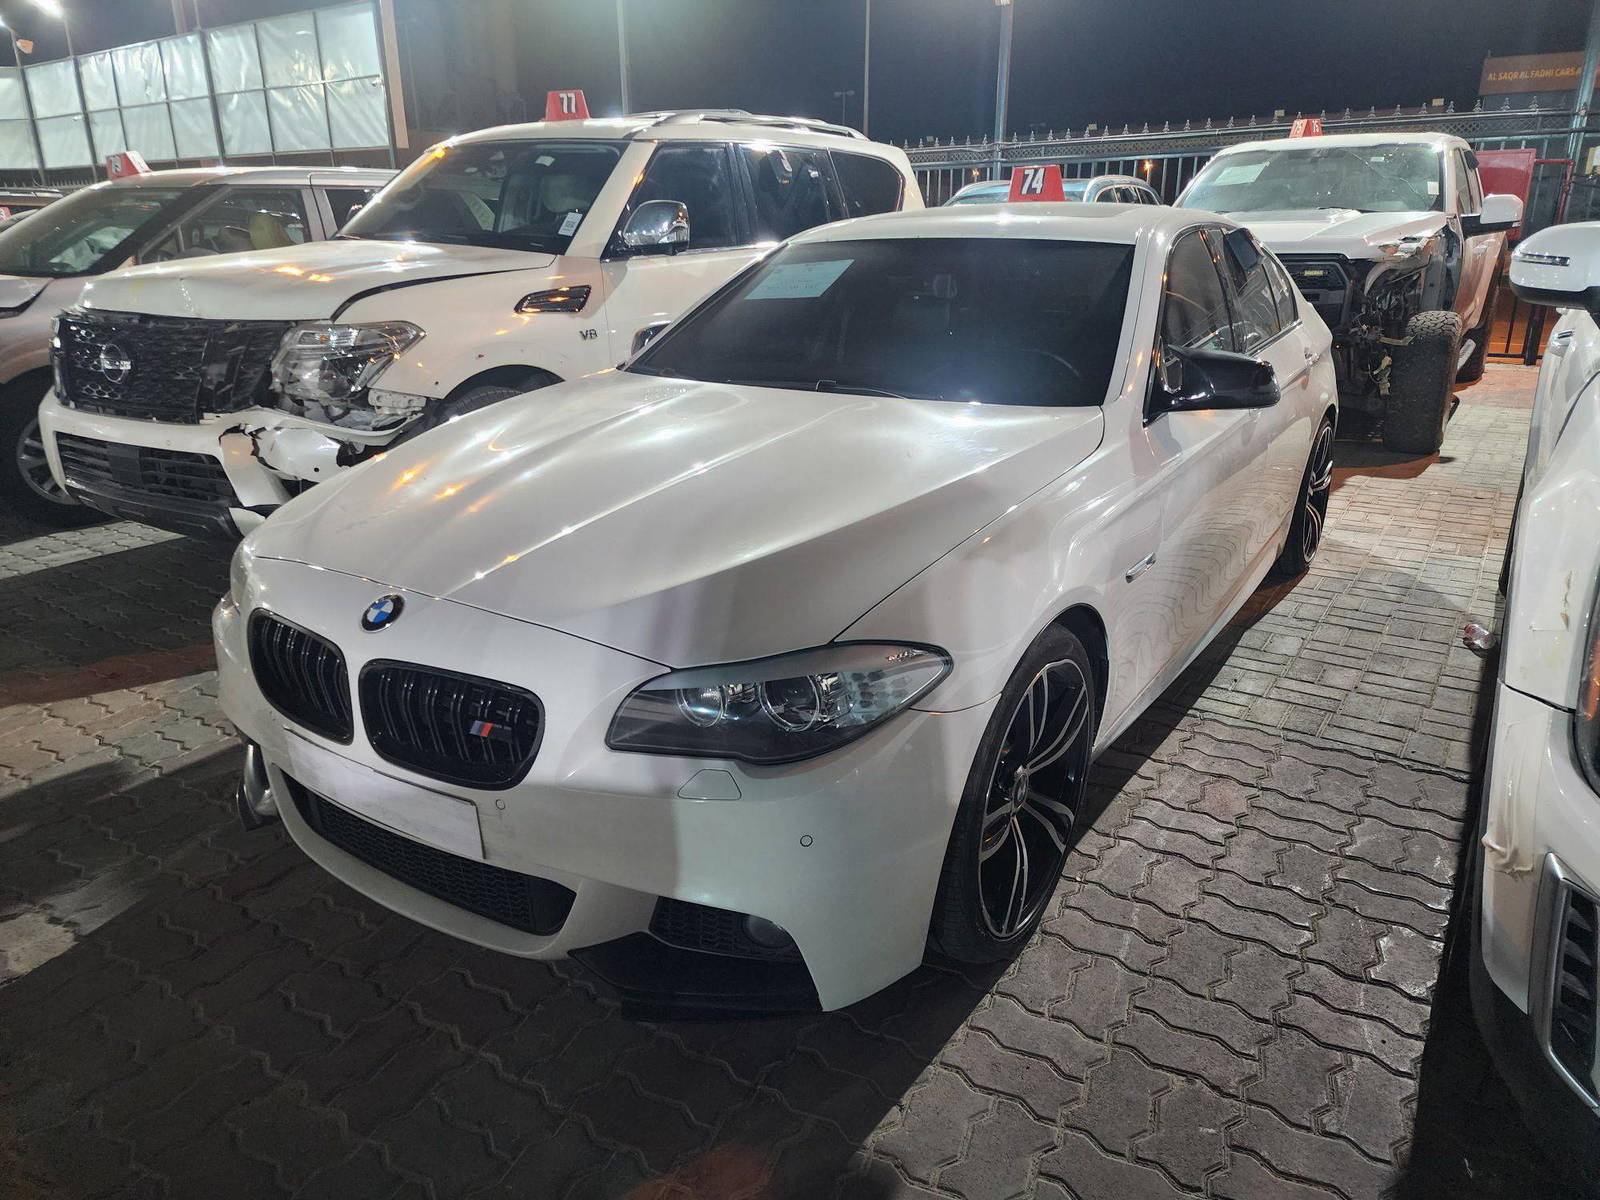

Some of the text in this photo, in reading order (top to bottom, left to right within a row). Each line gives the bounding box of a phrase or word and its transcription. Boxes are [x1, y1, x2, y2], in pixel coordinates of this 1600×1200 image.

[1488, 73, 1498, 81] AL
[559, 92, 576, 113] 77
[1021, 167, 1045, 195] 74
